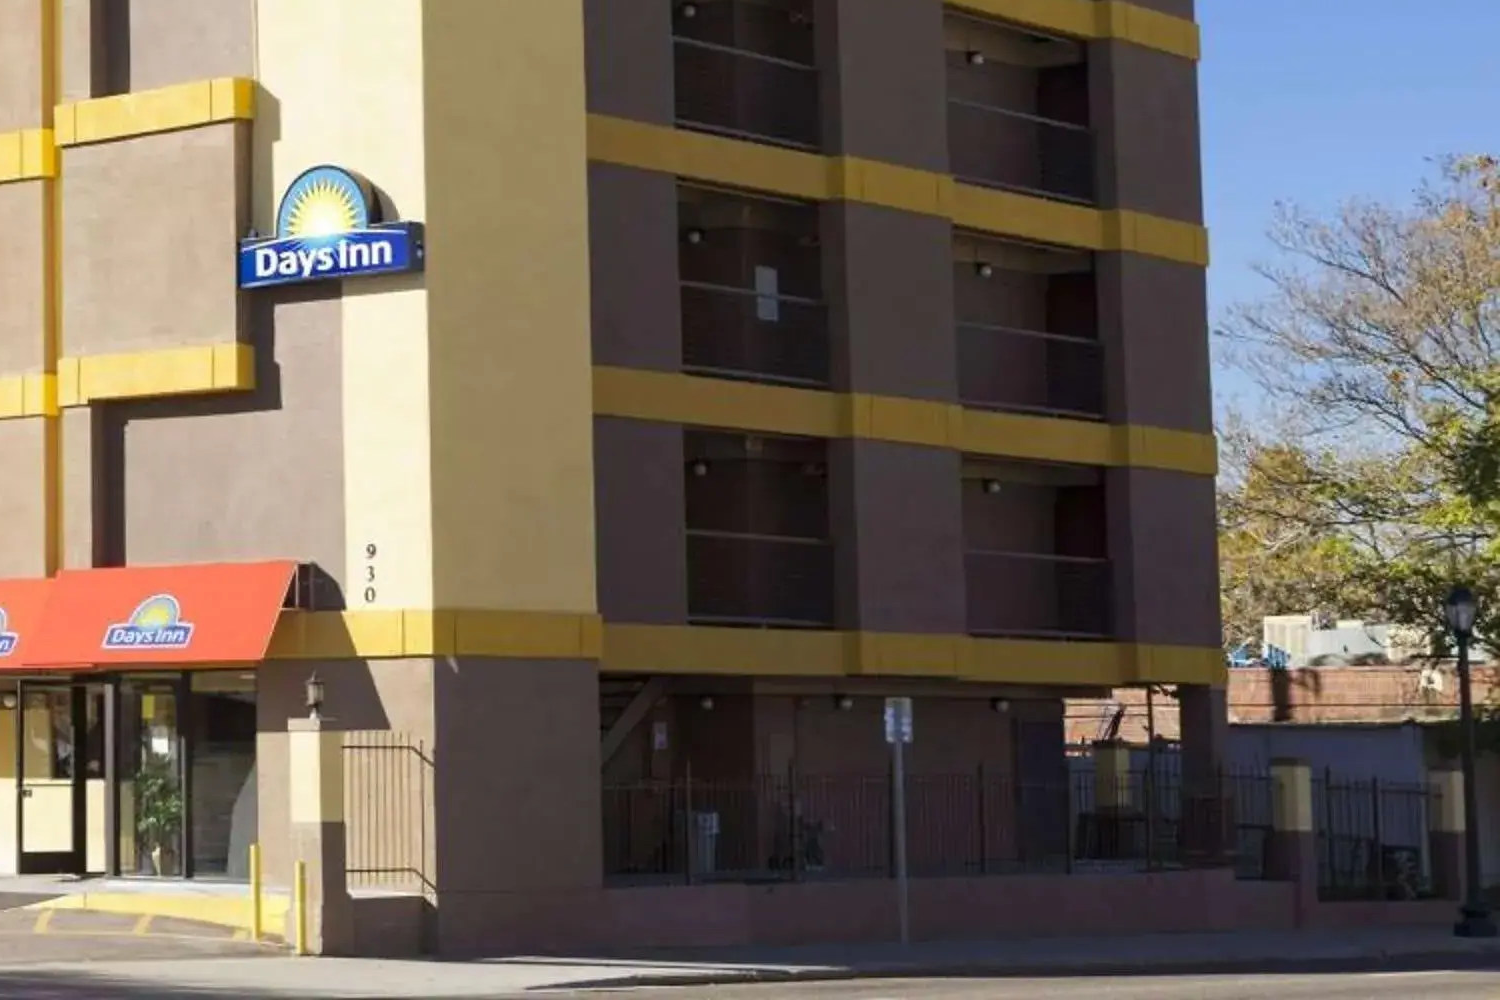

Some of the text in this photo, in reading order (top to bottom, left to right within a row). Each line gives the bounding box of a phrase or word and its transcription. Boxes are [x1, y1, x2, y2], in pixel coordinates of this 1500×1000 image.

[255, 240, 392, 277] Days Inn
[364, 543, 376, 603] 930
[111, 628, 185, 645] Days Inn
